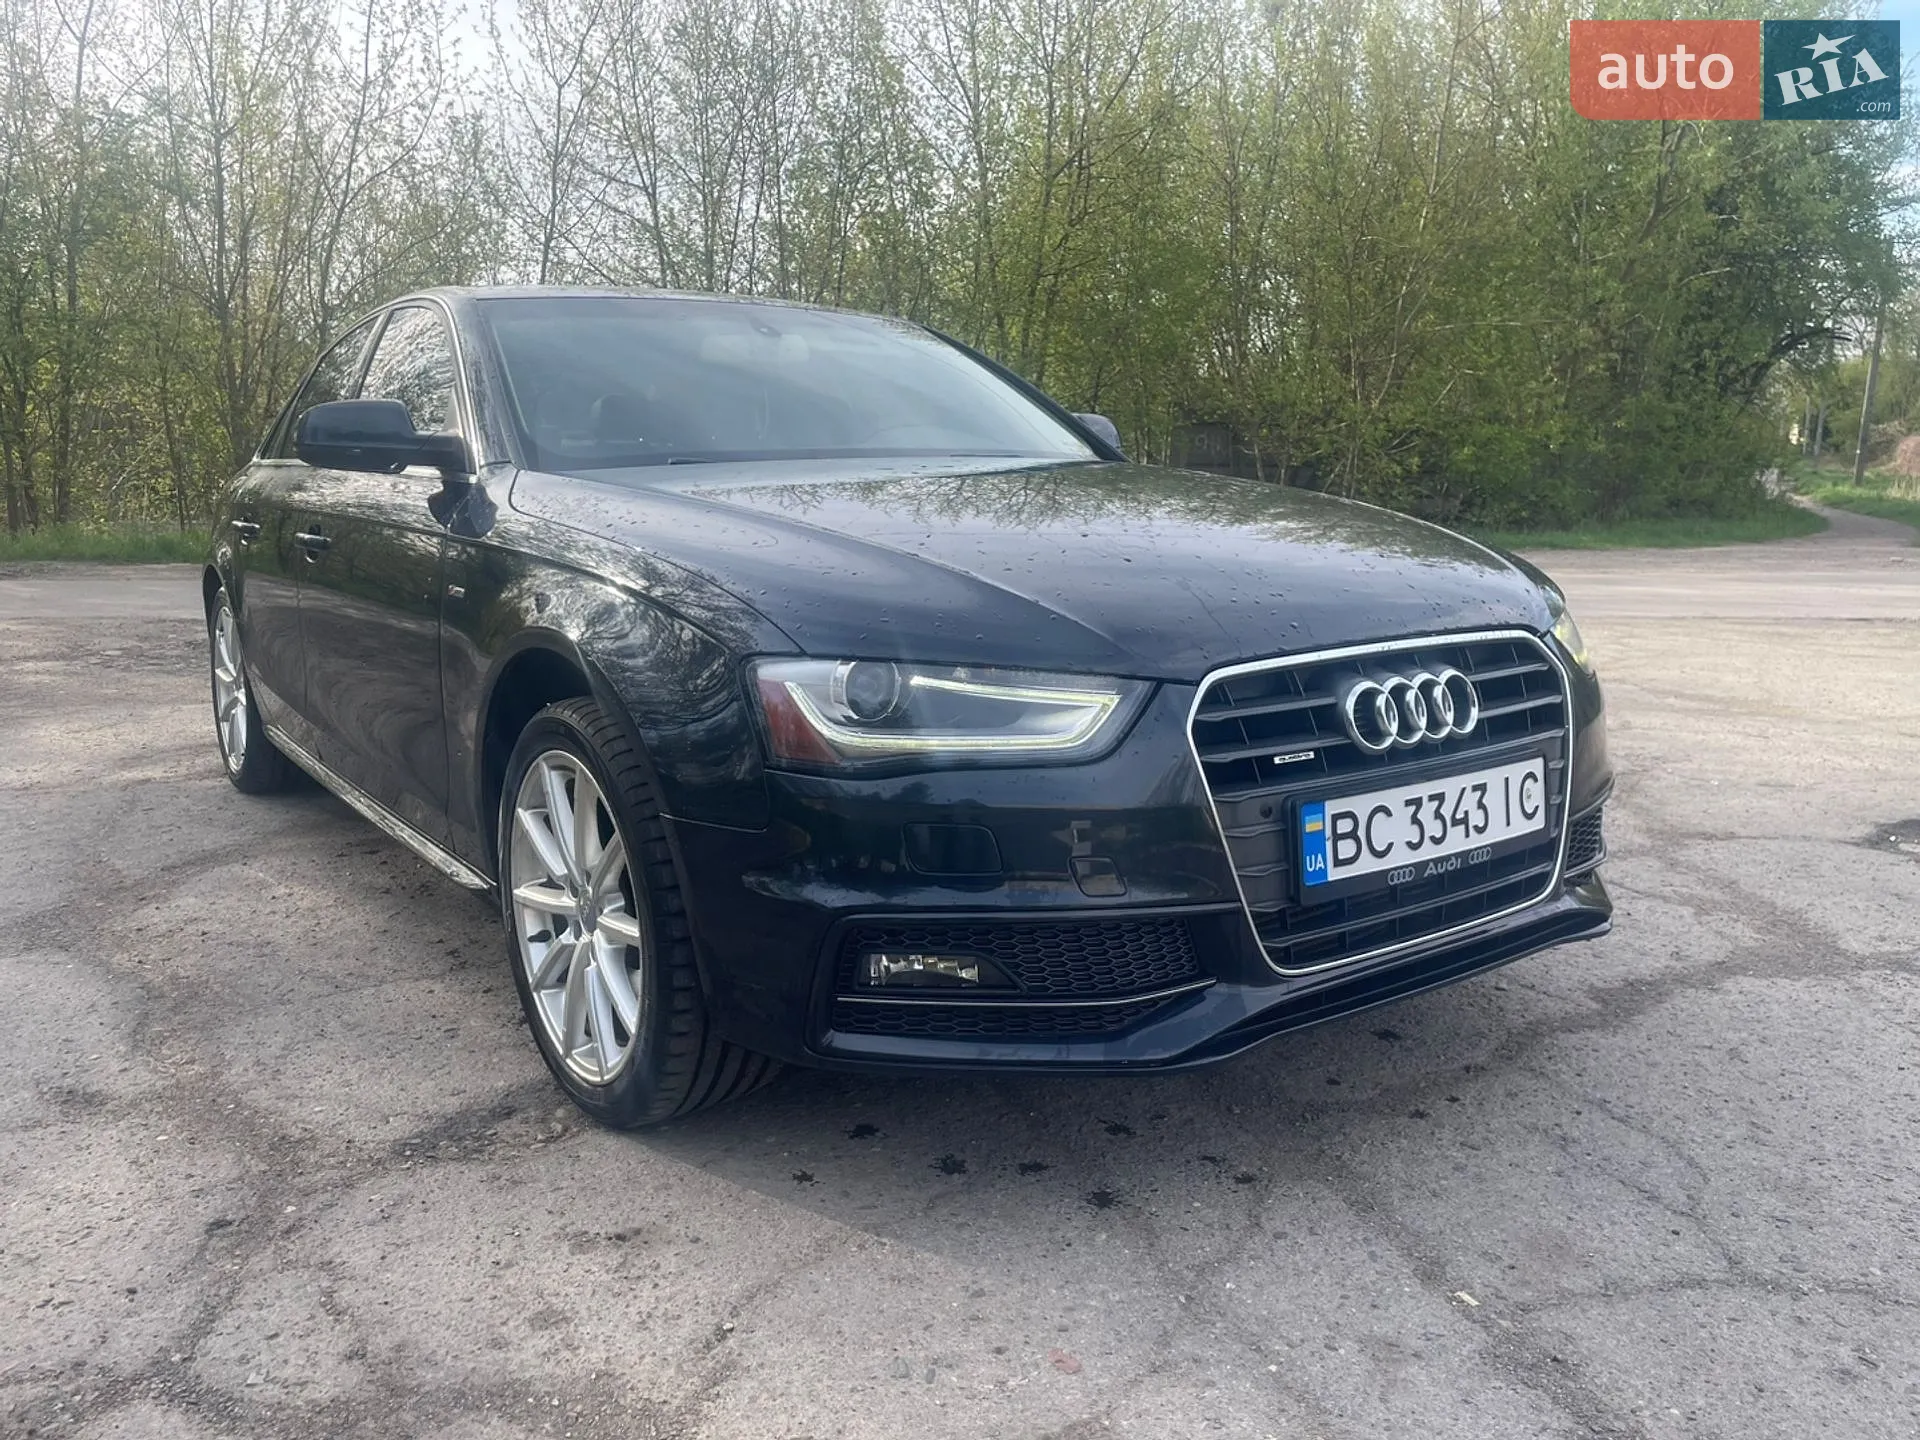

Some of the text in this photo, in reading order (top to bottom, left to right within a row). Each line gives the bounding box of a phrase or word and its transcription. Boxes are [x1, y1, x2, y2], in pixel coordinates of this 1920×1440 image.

[1331, 771, 1540, 868] BC 3343 IC
[1306, 855, 1325, 873] UA
[1423, 859, 1462, 878] Audi
